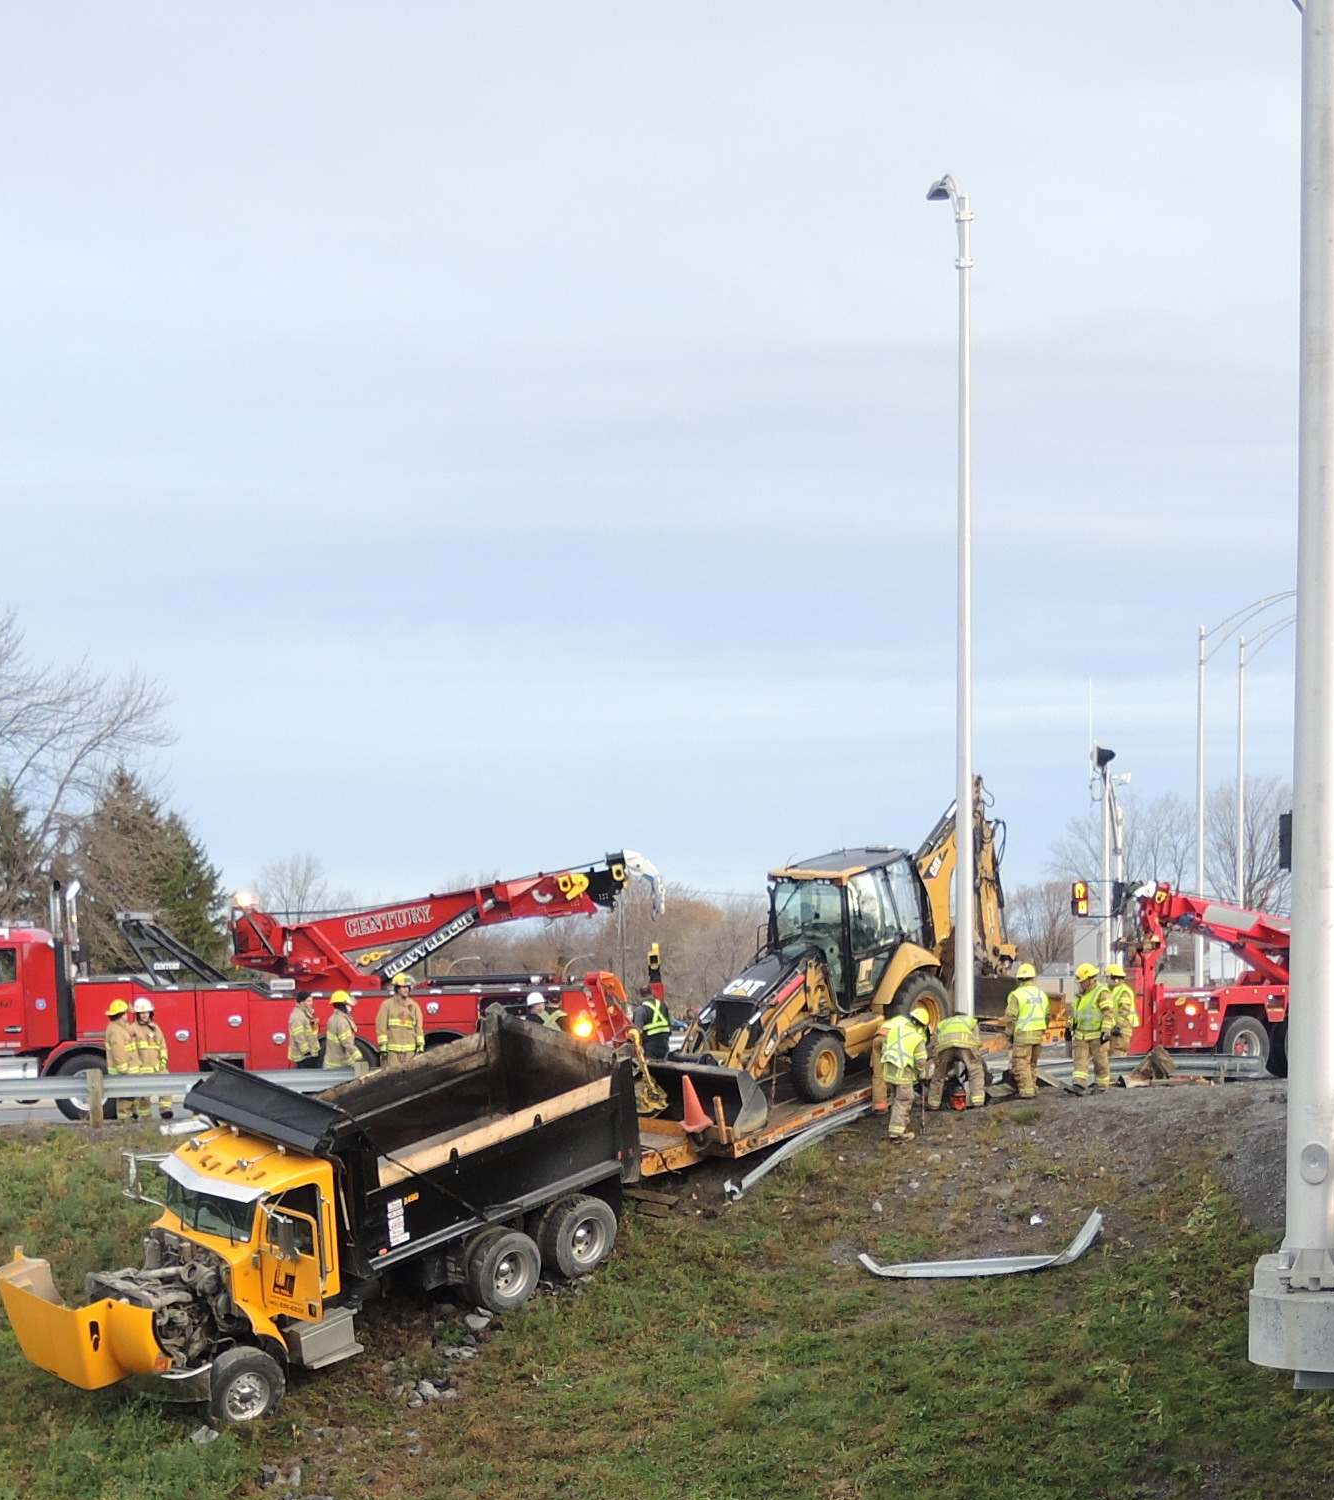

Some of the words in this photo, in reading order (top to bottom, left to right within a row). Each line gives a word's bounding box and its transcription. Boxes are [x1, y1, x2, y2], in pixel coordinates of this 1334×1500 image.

[345, 904, 430, 937] CENTURY
[385, 945, 427, 979] HEAVY
[424, 913, 475, 952] RESCUE
[723, 979, 766, 997] CAT
